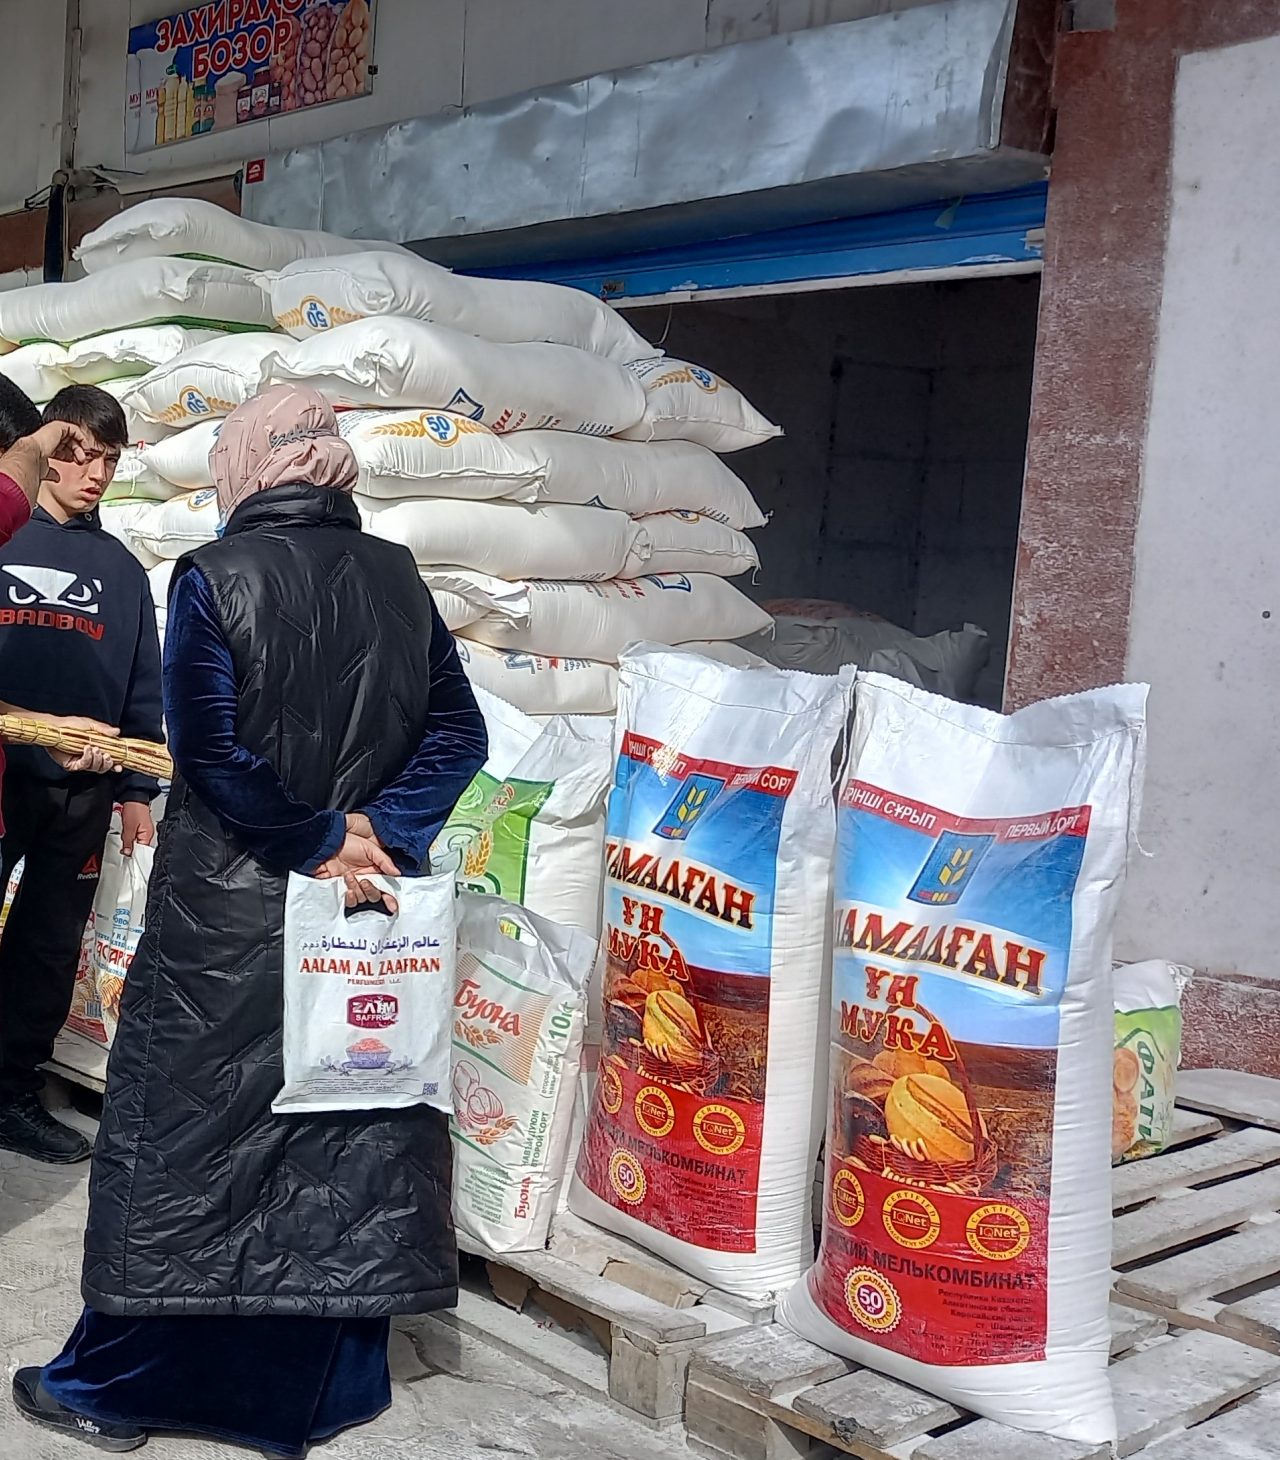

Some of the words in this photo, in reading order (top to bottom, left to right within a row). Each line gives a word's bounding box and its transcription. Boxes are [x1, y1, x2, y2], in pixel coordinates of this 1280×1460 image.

[192, 19, 293, 82] БОЗОР
[306, 310, 329, 329] 50
[187, 399, 209, 414] 50
[426, 415, 451, 432] 50
[606, 922, 690, 982] МУКА
[300, 957, 351, 975] AALAM
[355, 959, 375, 977] AL
[377, 956, 441, 976] ZAAFRAN
[454, 978, 521, 1037] Буона
[839, 999, 957, 1062] МУКА
[619, 1166, 634, 1185] 50
[885, 1191, 937, 1218] CERTIFIED
[892, 1211, 928, 1228] IQNet
[971, 1206, 1027, 1228] CERTIFIED
[979, 1225, 1019, 1239] IQNet
[872, 1250, 1037, 1290] МЕЛЬКОМБИНАТ
[858, 1287, 882, 1308] 50
